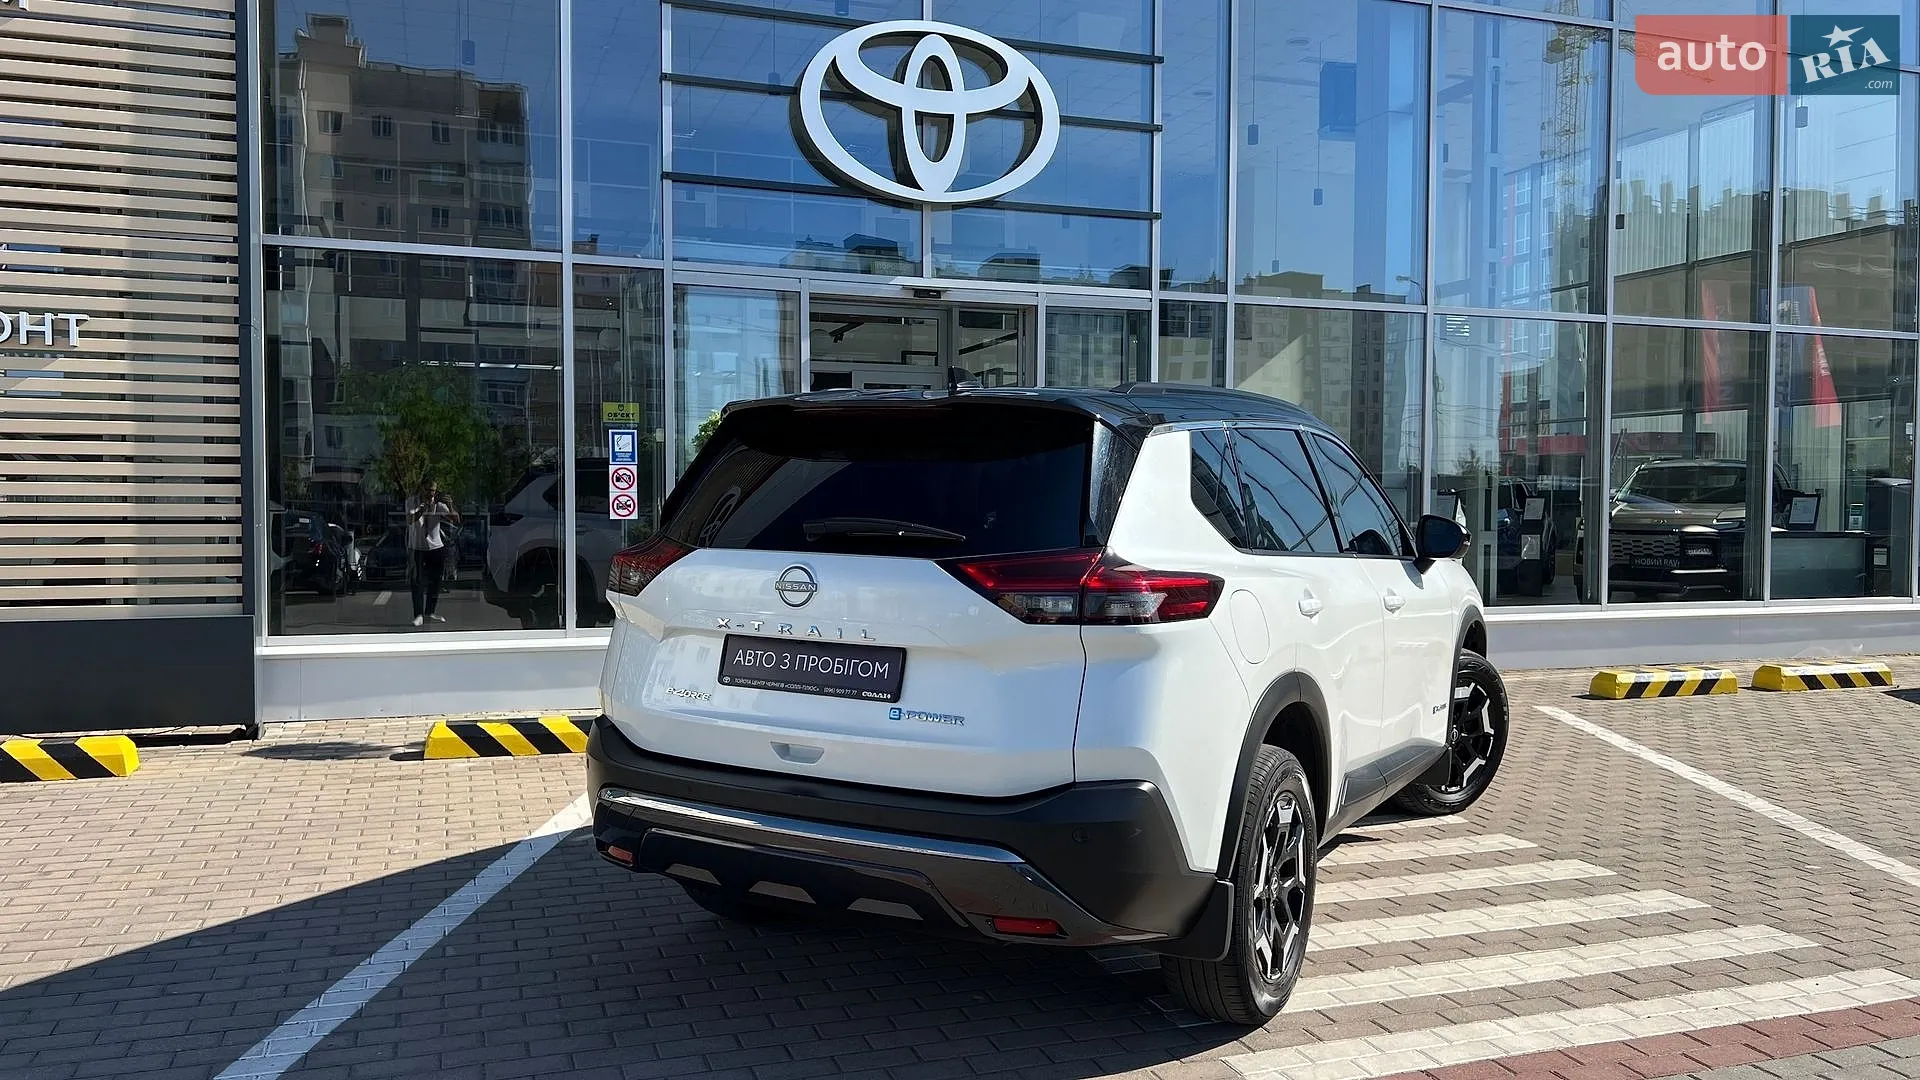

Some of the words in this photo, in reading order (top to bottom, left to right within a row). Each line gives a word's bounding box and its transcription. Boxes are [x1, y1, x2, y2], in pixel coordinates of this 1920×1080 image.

[775, 581, 817, 592] NISSAN
[716, 616, 877, 642] X-TRAIL
[733, 649, 776, 668] АВТО
[779, 652, 791, 670] З
[794, 654, 889, 679] ПРОБІГОМ
